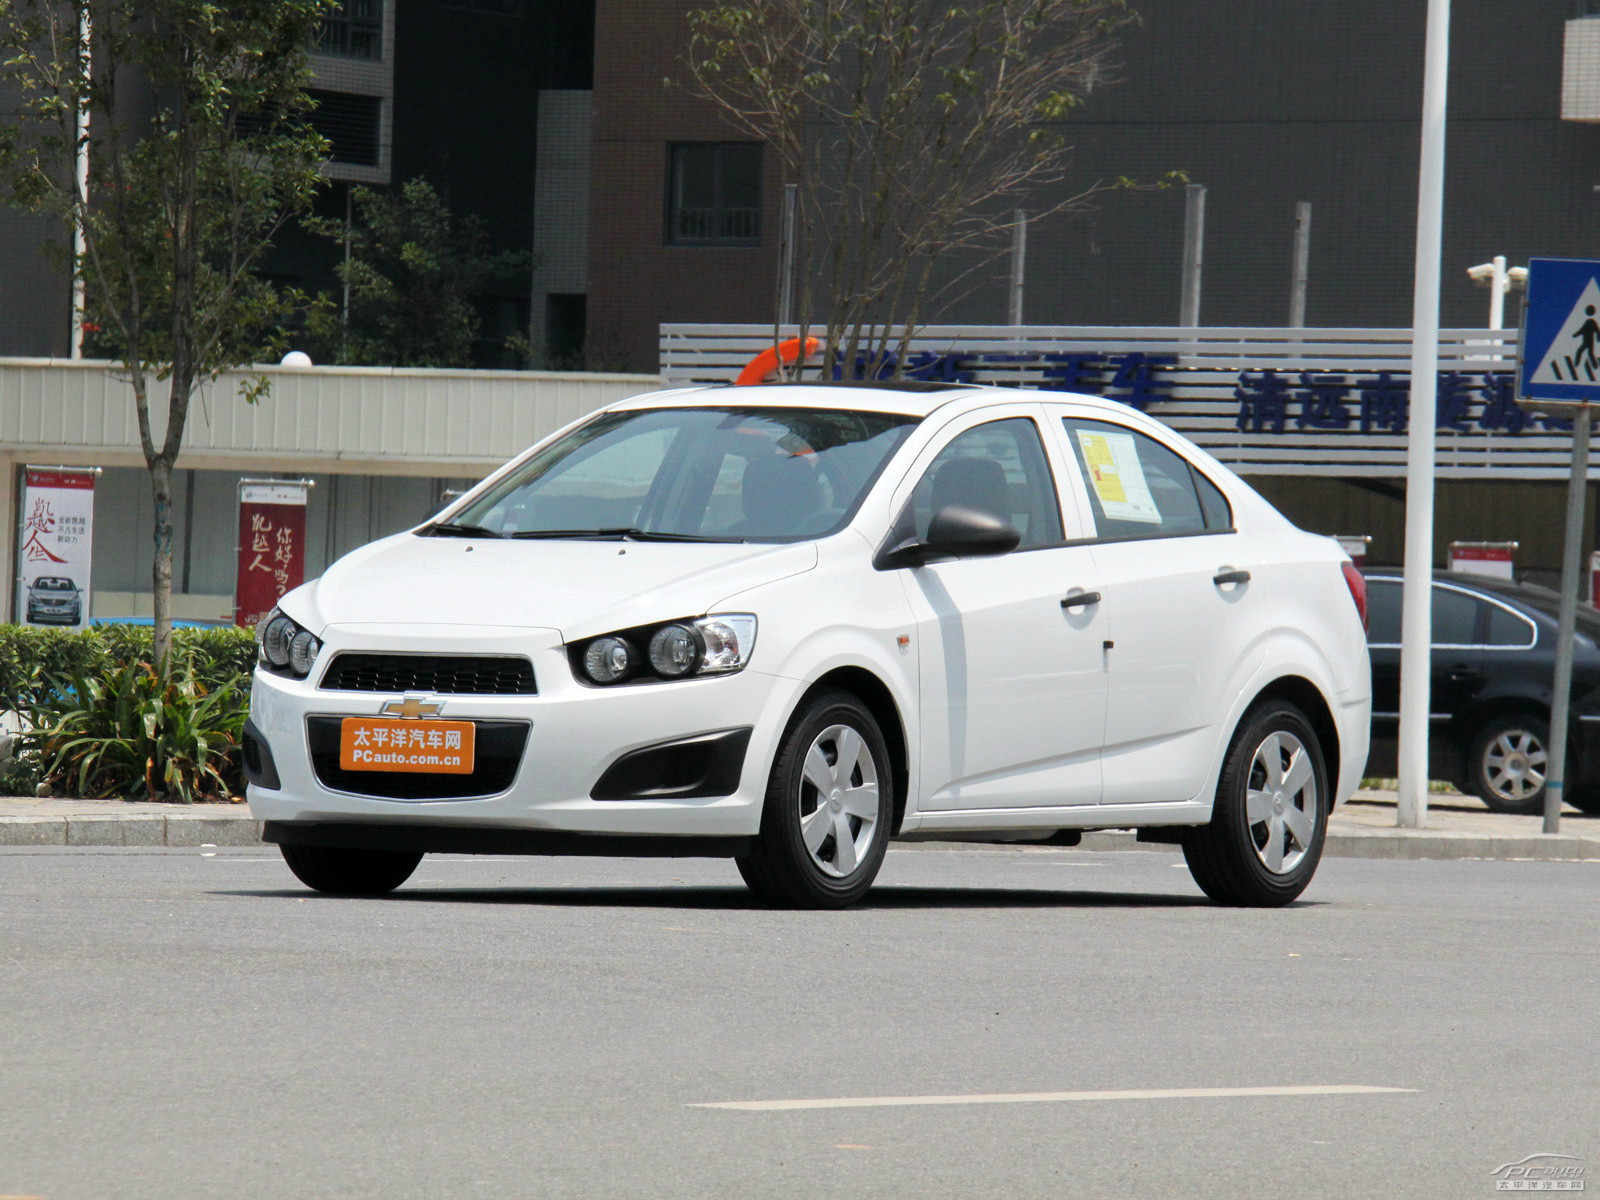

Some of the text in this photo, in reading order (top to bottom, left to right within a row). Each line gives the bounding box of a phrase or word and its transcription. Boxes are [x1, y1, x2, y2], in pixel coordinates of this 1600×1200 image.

[22, 498, 69, 564] 凯越人生
[249, 513, 272, 572] 凯越人
[353, 727, 461, 749] 太平洋汽车网
[353, 749, 461, 766] PCauto.com.cn
